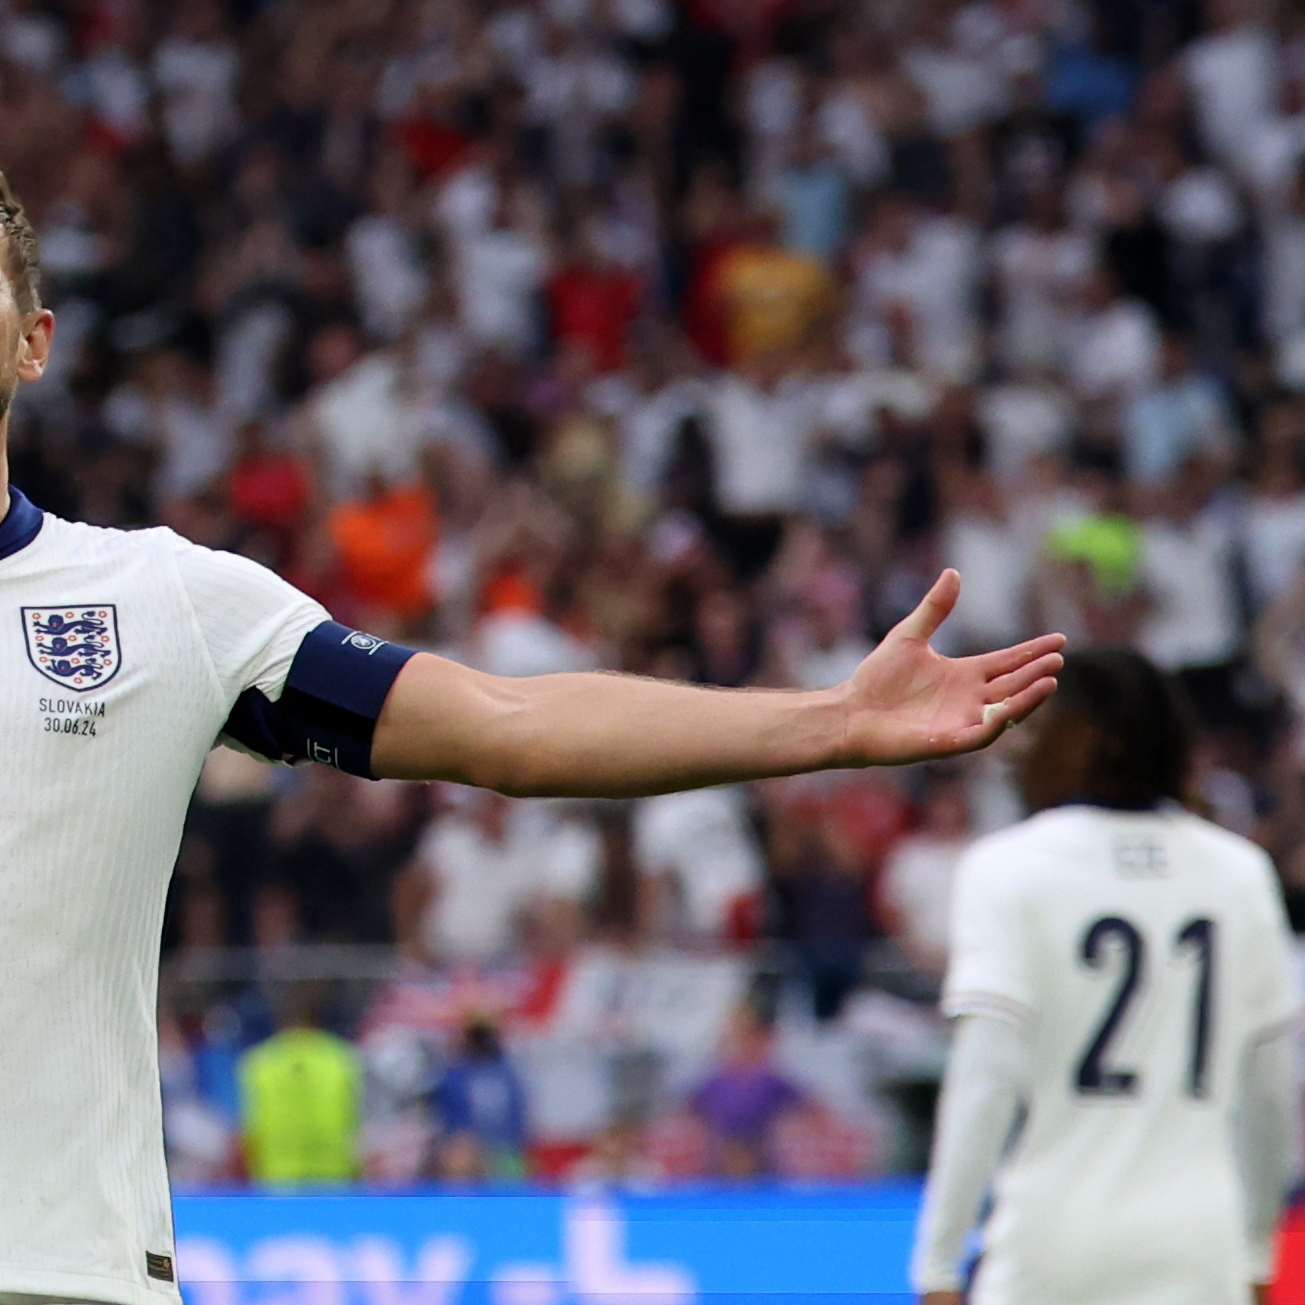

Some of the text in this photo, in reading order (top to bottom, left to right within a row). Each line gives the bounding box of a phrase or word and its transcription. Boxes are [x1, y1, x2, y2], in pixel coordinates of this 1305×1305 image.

[39, 698, 106, 718] SLOVAKIA
[43, 717, 97, 737] 30.06.24
[1074, 913, 1219, 1098] 21
